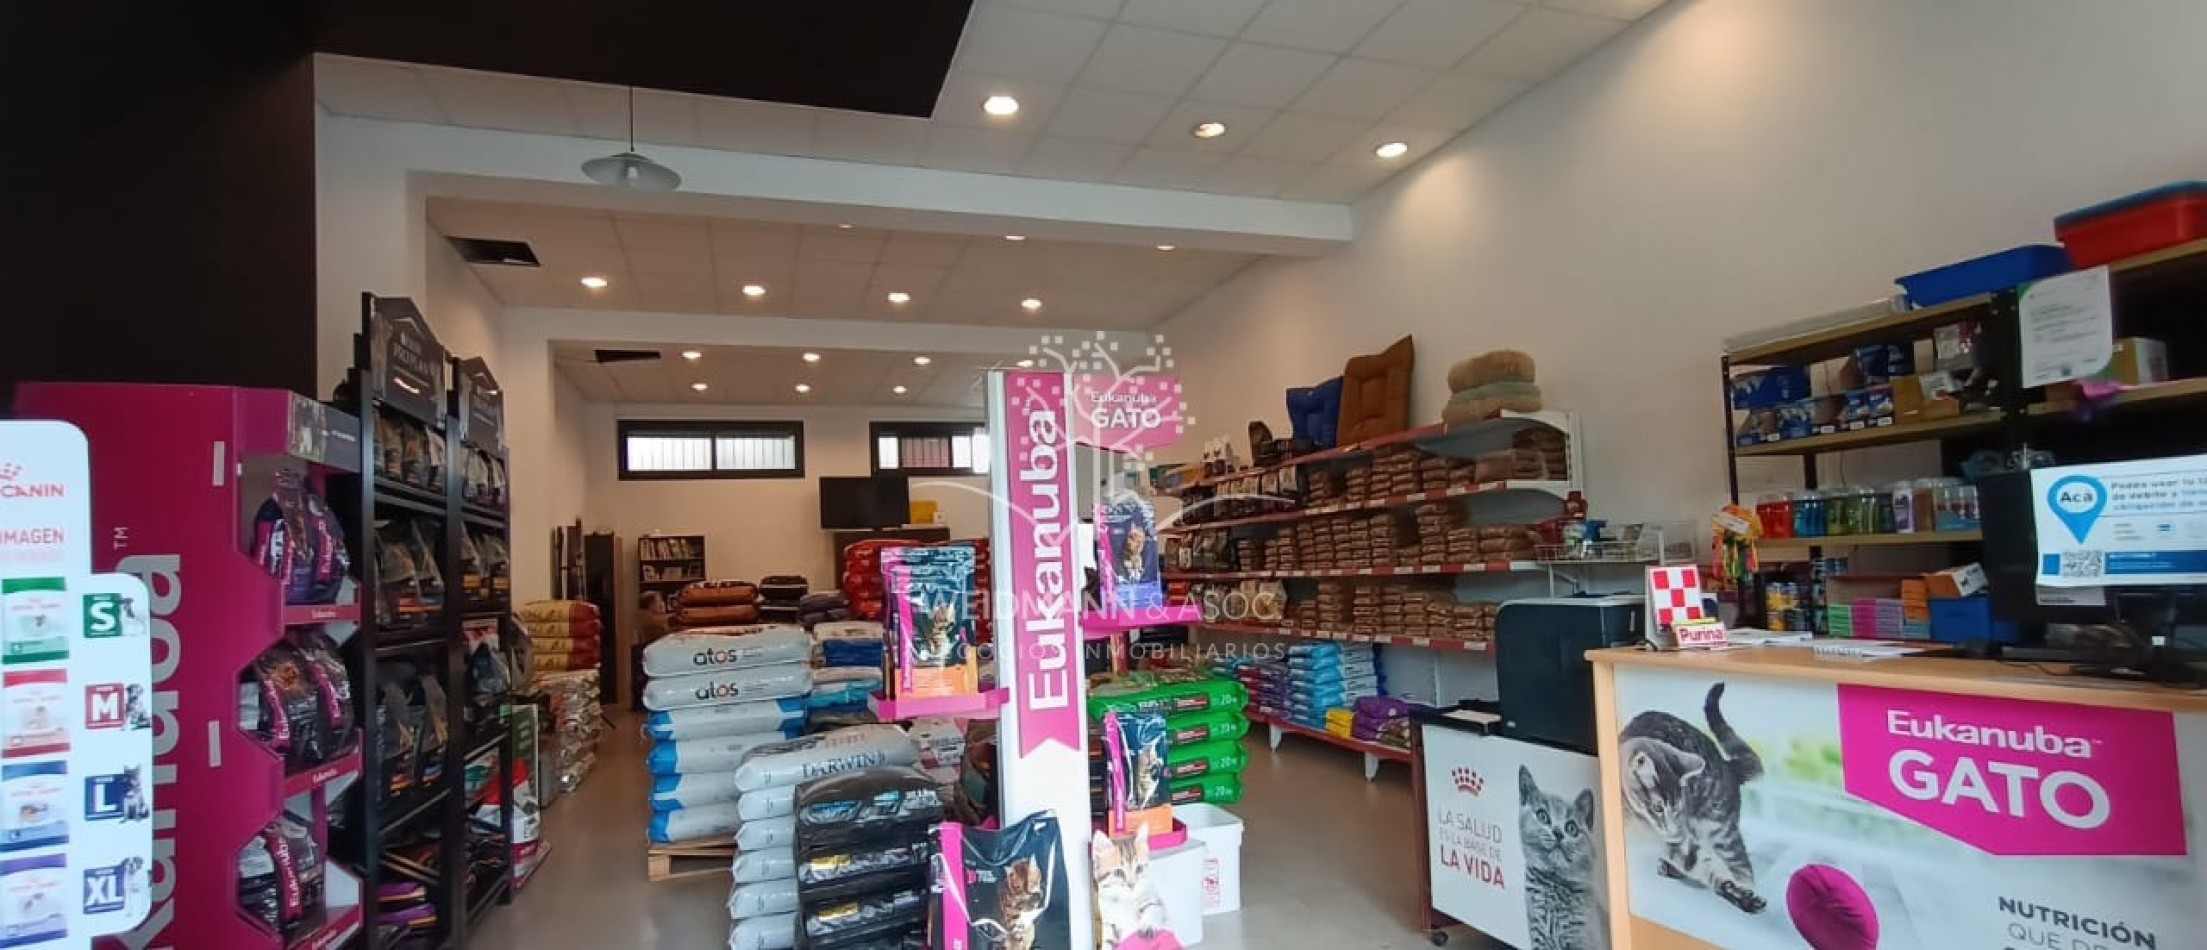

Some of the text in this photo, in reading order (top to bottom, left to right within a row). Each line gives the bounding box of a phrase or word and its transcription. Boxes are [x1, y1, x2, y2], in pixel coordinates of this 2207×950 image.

[1091, 408, 1161, 429] GATO
[1, 484, 65, 498] CANIN
[0, 527, 65, 545] IMAGEN
[1020, 409, 1069, 711] Eukanuba
[90, 601, 116, 632] S
[1678, 627, 1724, 643] Purina
[692, 648, 738, 667] atos
[92, 692, 119, 722] M
[1887, 709, 2092, 759] Eukanuba
[95, 784, 117, 813] L
[1889, 749, 2111, 829] GATO
[1457, 813, 1502, 844] SALUD
[1441, 842, 1505, 889] LA VIDA
[87, 875, 124, 906] XL
[1998, 895, 2156, 950] NUTRICIÓN
[2007, 922, 2063, 950] QUE
